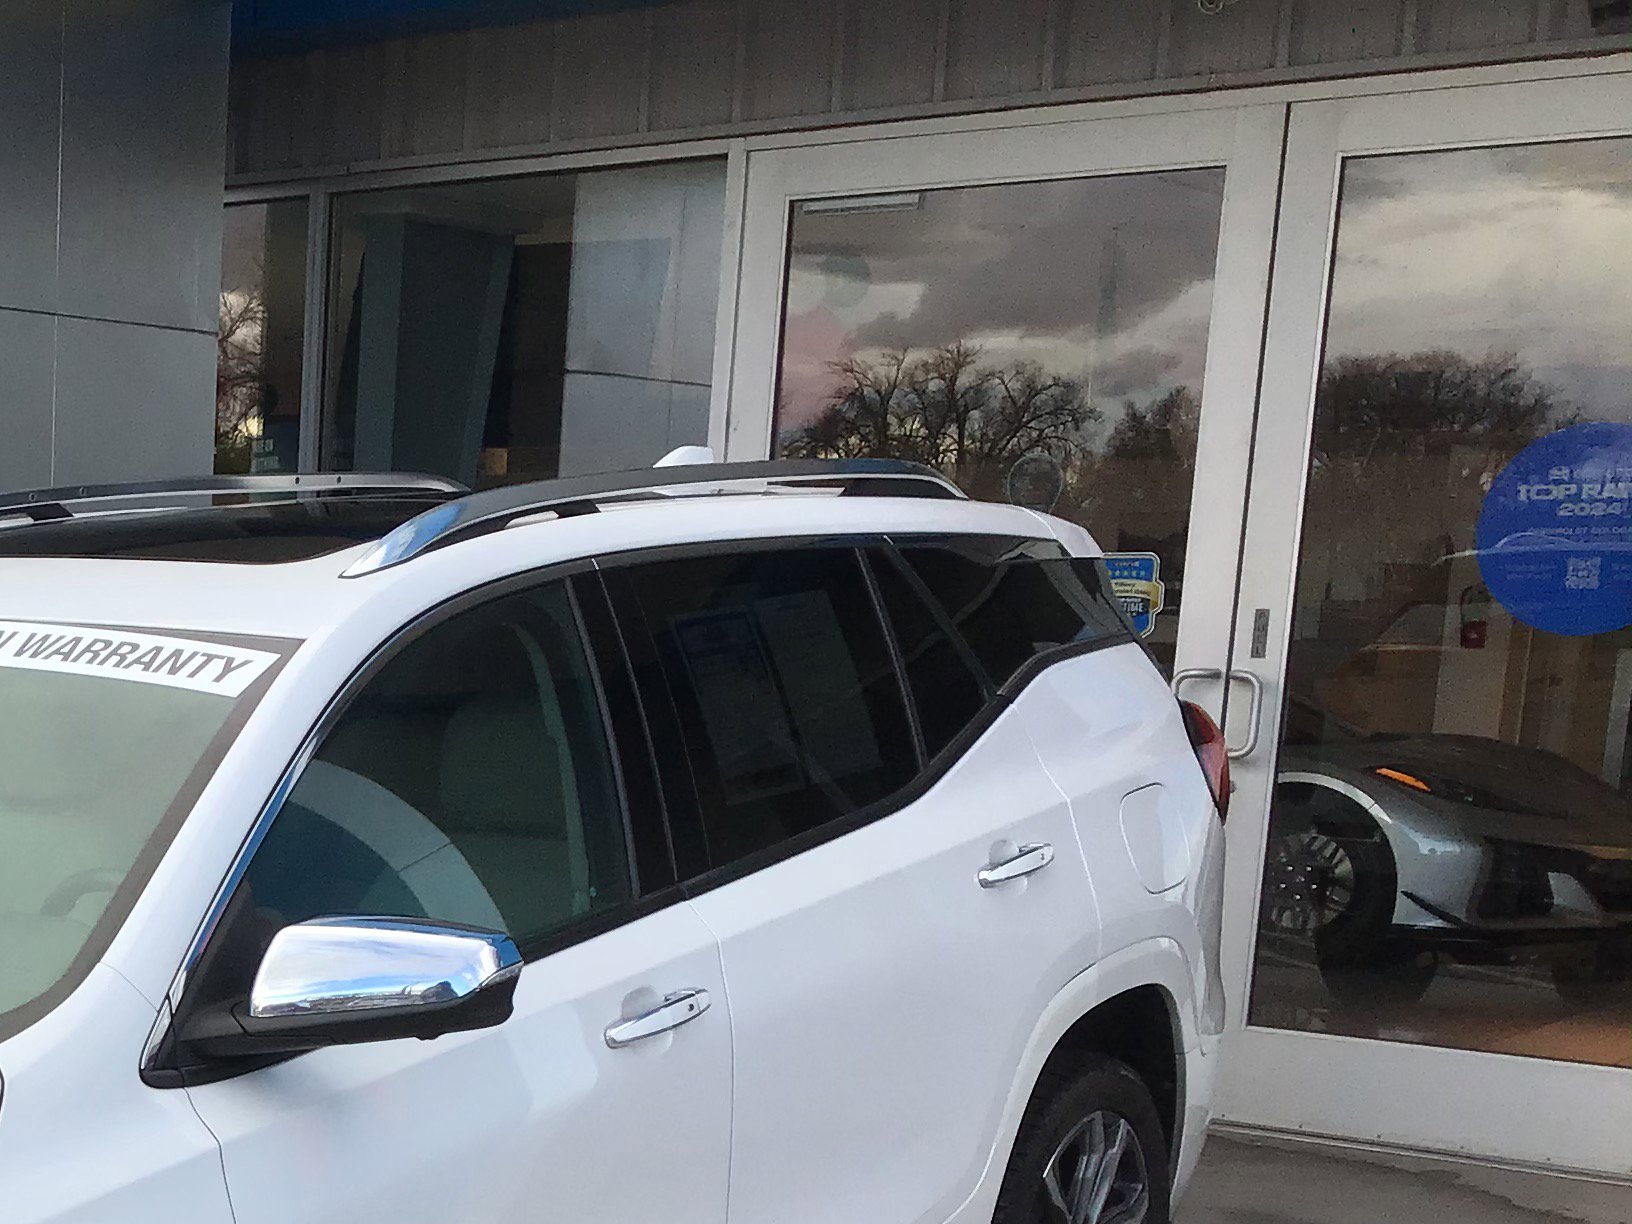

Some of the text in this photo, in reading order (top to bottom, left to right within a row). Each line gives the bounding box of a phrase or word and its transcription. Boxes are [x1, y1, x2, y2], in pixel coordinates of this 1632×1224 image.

[1517, 484, 1577, 500] TOP
[1556, 502, 1623, 516] 2024
[13, 632, 254, 683] WARRANTY
